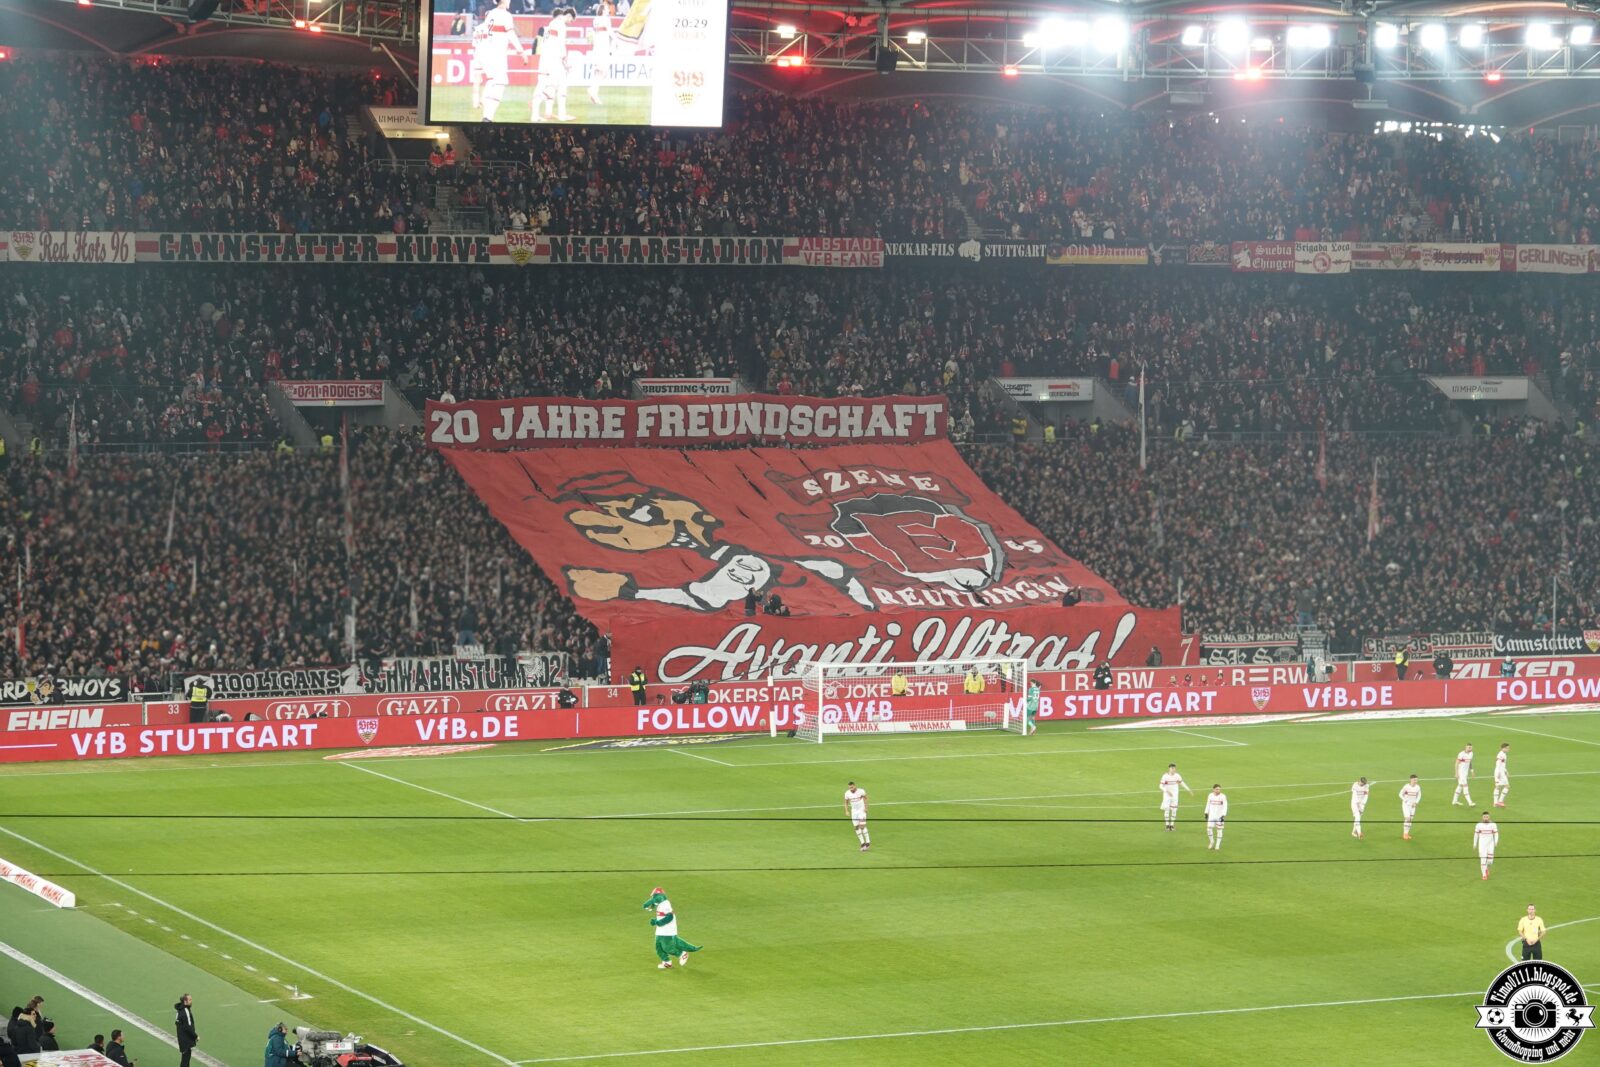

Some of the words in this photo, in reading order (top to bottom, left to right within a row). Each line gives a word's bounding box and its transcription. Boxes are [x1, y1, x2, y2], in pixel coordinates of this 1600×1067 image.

[675, 18, 708, 28] 20:29
[39, 229, 69, 262] Red
[73, 231, 106, 262] Hots
[111, 231, 129, 262] 96
[159, 234, 379, 262] CANNSTATTER
[396, 235, 490, 263] KURVE
[550, 236, 784, 264] NECKARSTADION
[801, 238, 883, 250] ALBSTADT
[885, 242, 955, 257] NECKAR-FILS
[984, 244, 1047, 258] STUTTGART
[1066, 243, 1089, 257] Old
[1091, 243, 1147, 257] Warriors
[1296, 242, 1328, 254] Brigada
[804, 251, 881, 266] VFB-FANS
[1519, 248, 1586, 267] GERLINGEN
[297, 385, 319, 398] 0711
[322, 385, 366, 398] ADDICTS
[643, 384, 698, 394] BRUSTRING
[709, 385, 730, 394] 0711
[430, 409, 480, 444] 20
[492, 405, 626, 441] JAHRE
[636, 402, 943, 438] FREUNDSCHAFT
[803, 470, 940, 496] SZENE
[804, 534, 845, 549] 20
[872, 576, 1074, 607] REUTLINGEN
[658, 621, 902, 683] Avanti
[1410, 638, 1429, 652] 36
[1494, 634, 1583, 653] Cannstatter
[1371, 663, 1382, 673] 36
[211, 669, 341, 693] HOOLIGANS
[607, 688, 618, 698] 34
[1303, 686, 1393, 708] VfB.DE
[168, 704, 180, 714] 33
[1064, 691, 1217, 717] STUTTGART
[7, 708, 104, 731] EHEIM
[637, 706, 761, 731] FOLLOW
[772, 703, 806, 726] US
[822, 700, 893, 725] @VfB
[415, 715, 519, 741] VfB.DE
[71, 731, 127, 756] VfB
[140, 723, 318, 754] STUTTGART
